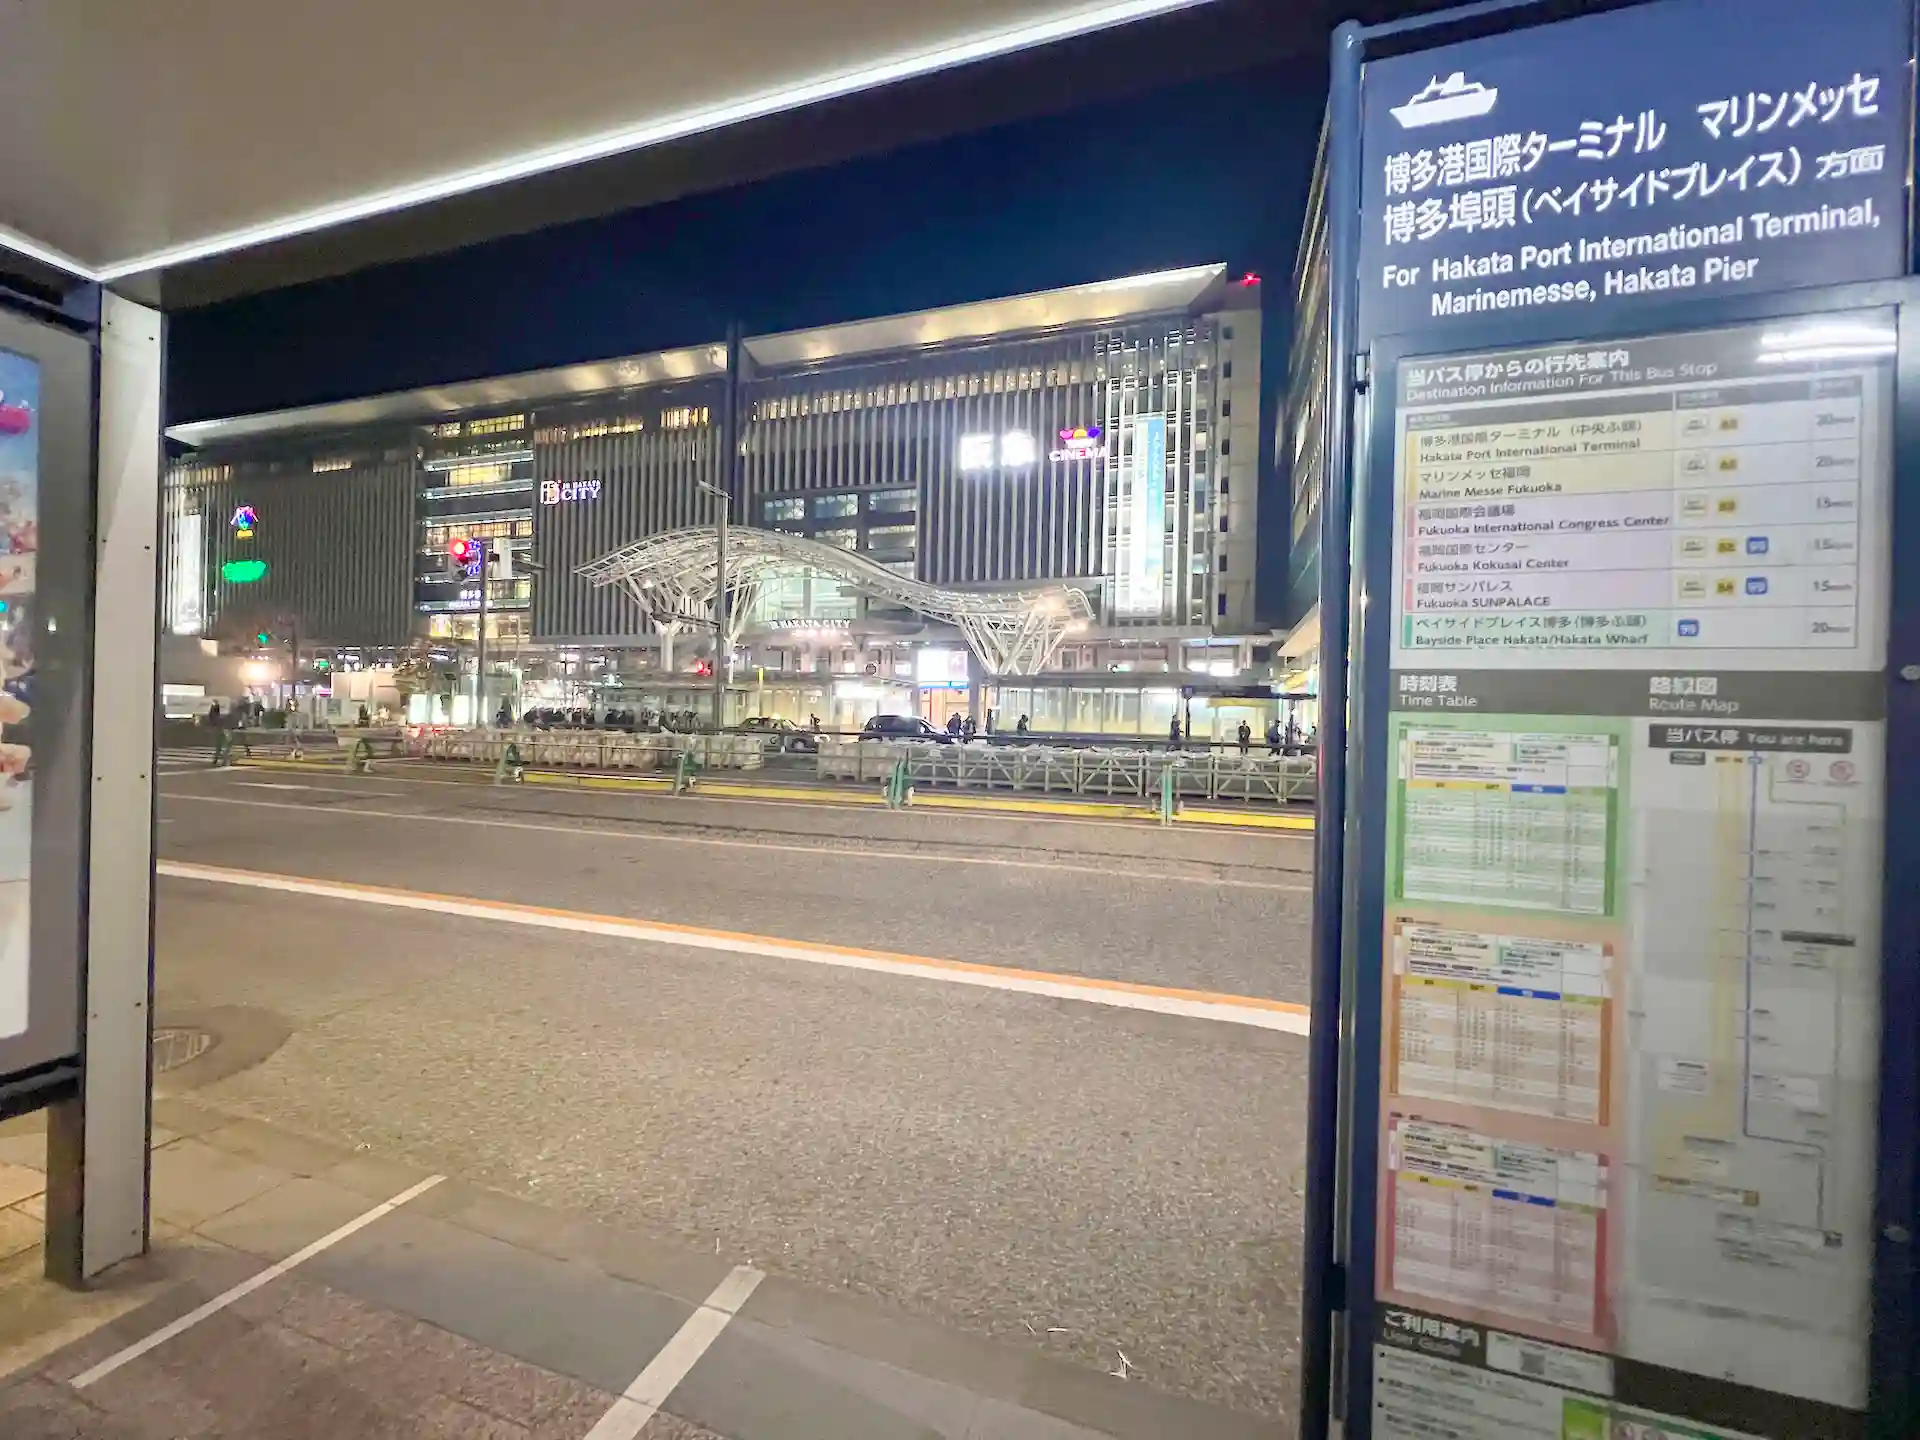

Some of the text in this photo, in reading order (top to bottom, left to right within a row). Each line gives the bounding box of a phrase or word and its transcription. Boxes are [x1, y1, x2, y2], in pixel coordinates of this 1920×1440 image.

[1383, 71, 1881, 196] 博多港国際ターミナル マリンメッセ
[1815, 143, 1885, 181] 方面
[1382, 198, 1882, 288] For Hakata Port International Terminal,
[1431, 255, 1760, 318] Marinemesse, Hakata Pier
[1405, 347, 1630, 388] 当バス停からの行先案内
[1405, 360, 1719, 403] Destination Information For This Bus Stop
[1049, 446, 1107, 462] CINEMA
[1419, 437, 1641, 464] Hakata Port International Terminal
[1418, 464, 1532, 484] マリンメッセ福岡
[561, 486, 601, 501] CITY
[1418, 482, 1563, 501] Marine Messe Fukuoka
[1417, 515, 1671, 537] Fukuoka International Congress Center
[1417, 557, 1570, 573] Fukuoka Kokusai Center
[1416, 595, 1551, 610] Fukuoka SUNPALACE
[1415, 634, 1463, 647] Bayside
[1466, 633, 1500, 646] Place
[1606, 632, 1650, 645] Wharf
[1399, 673, 1458, 693] 時刻表
[1399, 694, 1479, 707] Time Table
[1649, 697, 1740, 715] Route Map
[1665, 727, 1740, 744] 当バス停
[1746, 733, 1844, 746] You are here
